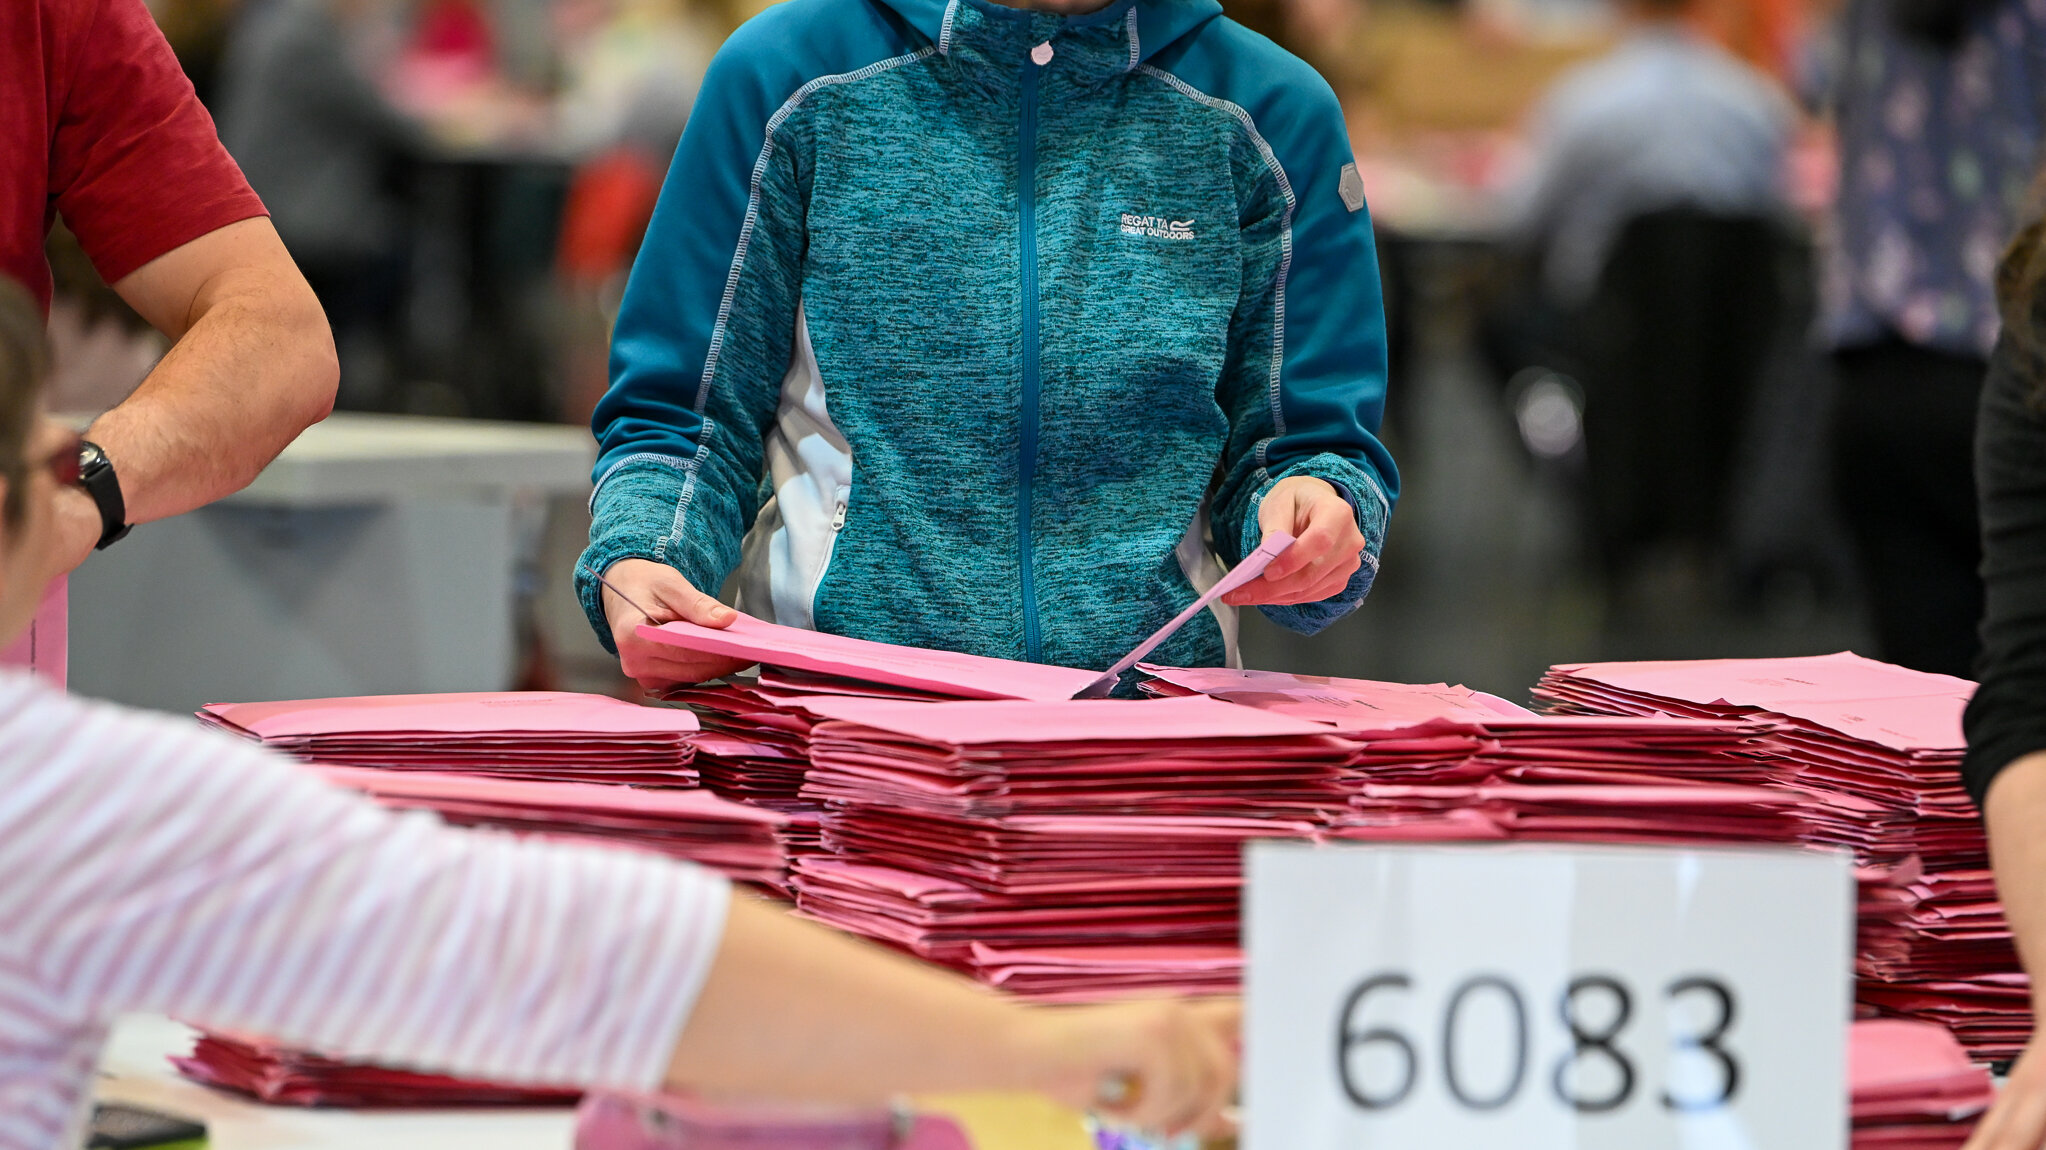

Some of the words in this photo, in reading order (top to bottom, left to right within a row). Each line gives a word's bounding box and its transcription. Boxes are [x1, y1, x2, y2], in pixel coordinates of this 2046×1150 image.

[1121, 213, 1168, 230] REGATTA
[1120, 224, 1146, 236] GREAT
[1146, 227, 1195, 240] OUTDOORS
[1336, 973, 1740, 1112] 6083
